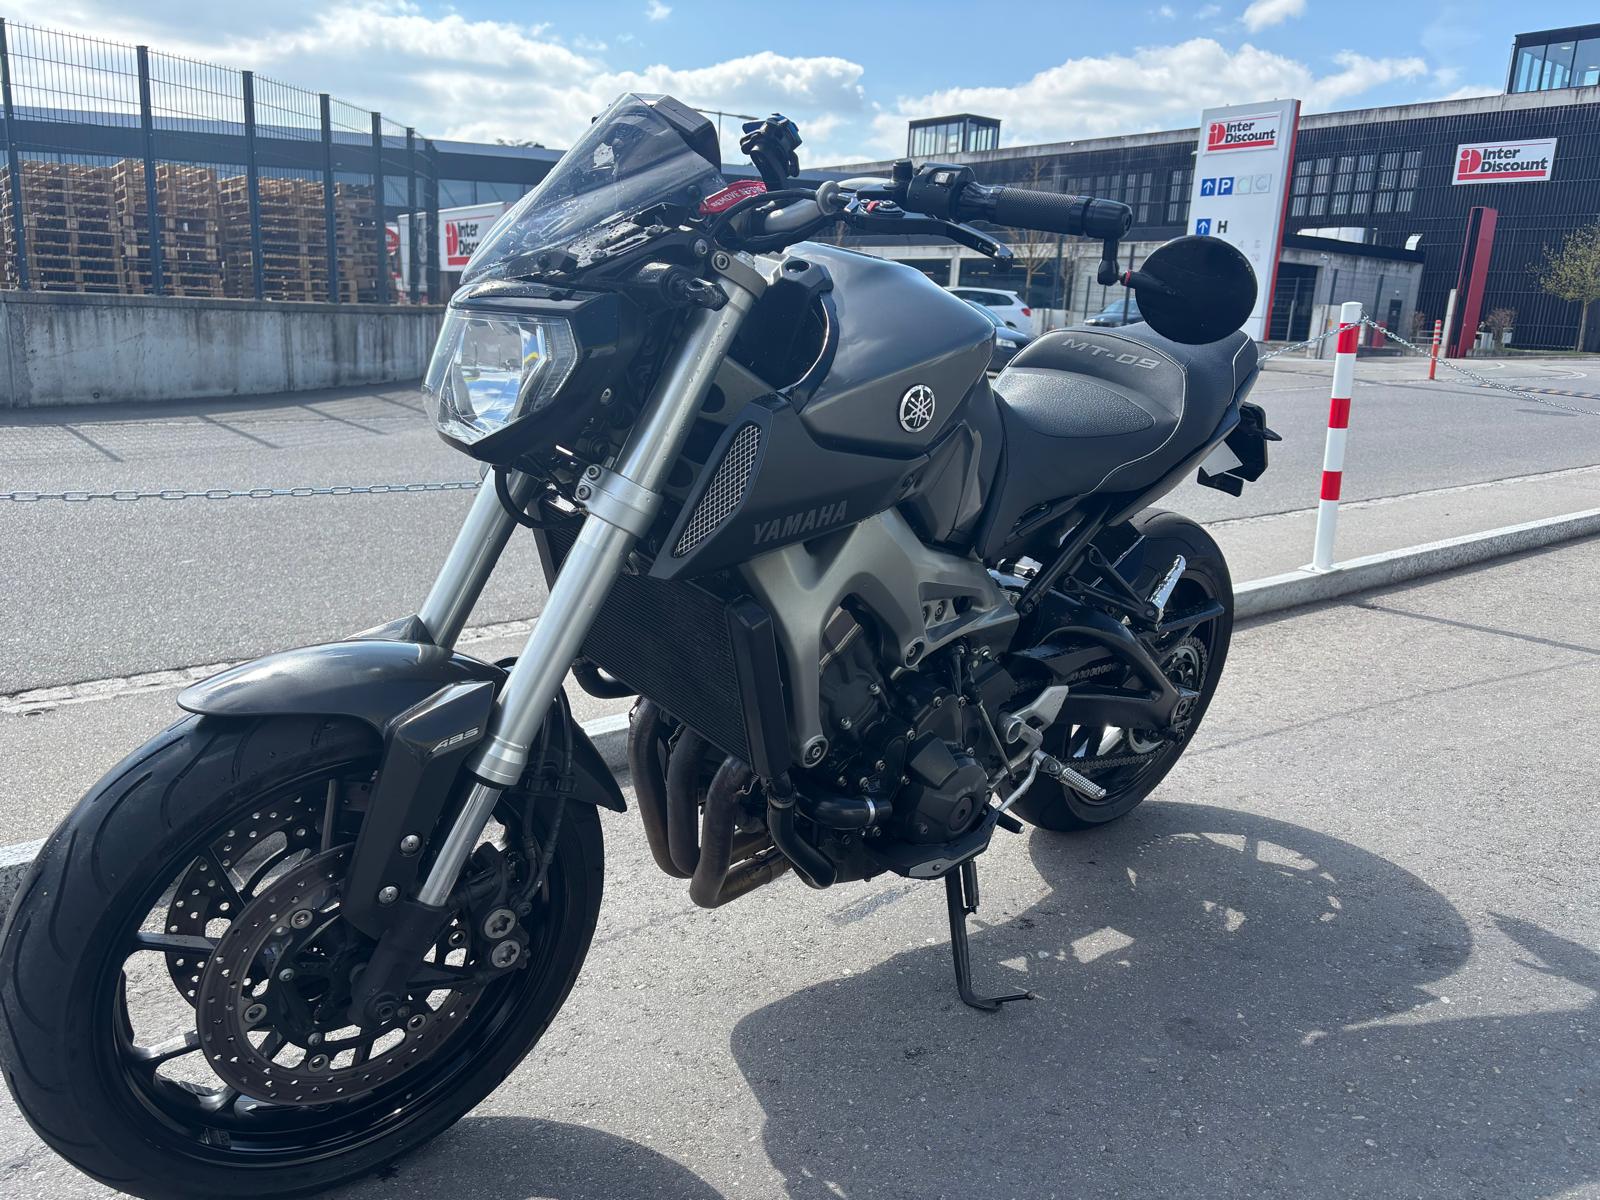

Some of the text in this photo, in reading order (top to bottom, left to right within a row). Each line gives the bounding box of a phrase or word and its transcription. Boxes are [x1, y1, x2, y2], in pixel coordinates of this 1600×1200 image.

[1226, 121, 1255, 133] Inter
[1225, 128, 1276, 144] Discount
[1482, 148, 1521, 160] Inter
[1480, 157, 1549, 173] Discount
[1220, 179, 1231, 193] P
[457, 222, 479, 237] Inter
[1217, 220, 1229, 233] H
[1062, 338, 1162, 370] MT-09
[753, 499, 848, 545] YAMAHA
[432, 727, 480, 753] ABS
